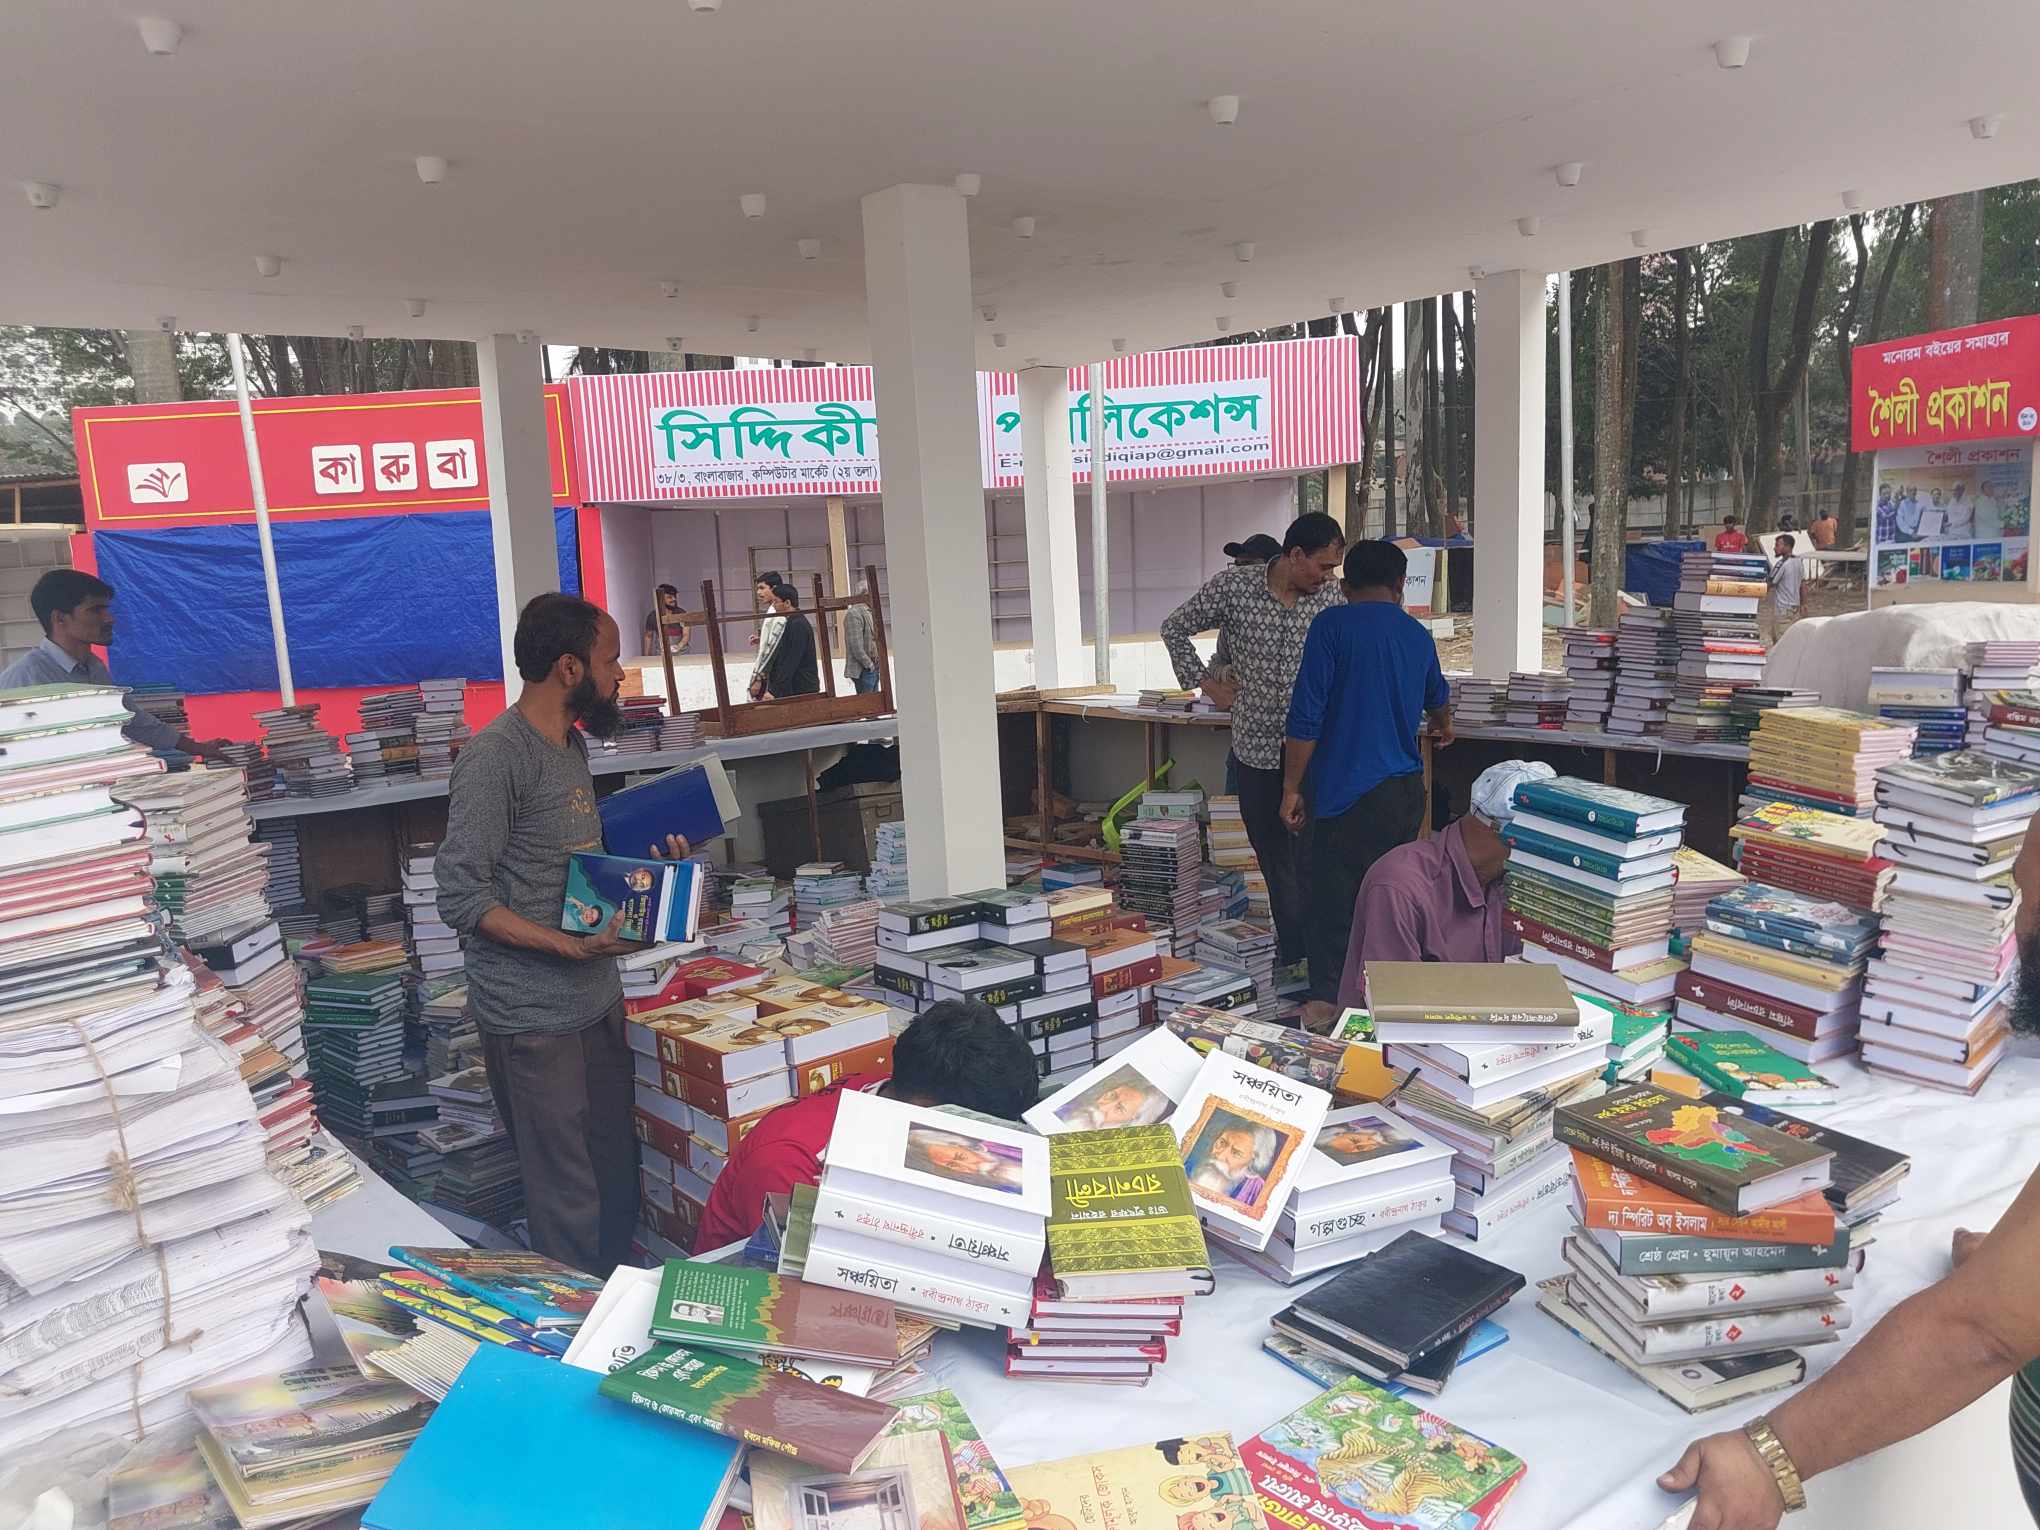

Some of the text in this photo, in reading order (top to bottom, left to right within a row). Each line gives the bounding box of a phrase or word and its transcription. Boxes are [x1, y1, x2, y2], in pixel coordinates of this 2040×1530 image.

[1882, 331, 2011, 364] মনোরম বইয়ের সমাহার
[1868, 377, 2011, 437] শৈলী প্রকাশন
[654, 402, 877, 463] সিদ্দিকী
[318, 446, 467, 486] কারুবা
[1073, 441, 1270, 464] sidiqiap@gmail.com
[751, 466, 798, 481] কম্পিউটার
[800, 465, 829, 479] মার্কেট
[1232, 1069, 1302, 1107] সঞ্চয়িতা
[1065, 1173, 1165, 1208] রচনাবলী
[1070, 1207, 1107, 1220] রহমান
[1309, 1211, 1367, 1239] গল্পগুচ্ছ
[1608, 1209, 1619, 1225] দ্য
[1621, 1207, 1654, 1227] স্পিরিট
[1675, 1209, 1708, 1233] ইসলাম
[948, 1232, 1011, 1262] সঞ্চয়িতা
[1639, 1248, 1662, 1264] শ্রেষ্ঠ
[1666, 1247, 1689, 1262] প্রেম
[1740, 1243, 1786, 1259] আহমেদ
[837, 1266, 898, 1295] সঞ্চয়িতা
[1258, 1475, 1311, 1509] মালা
